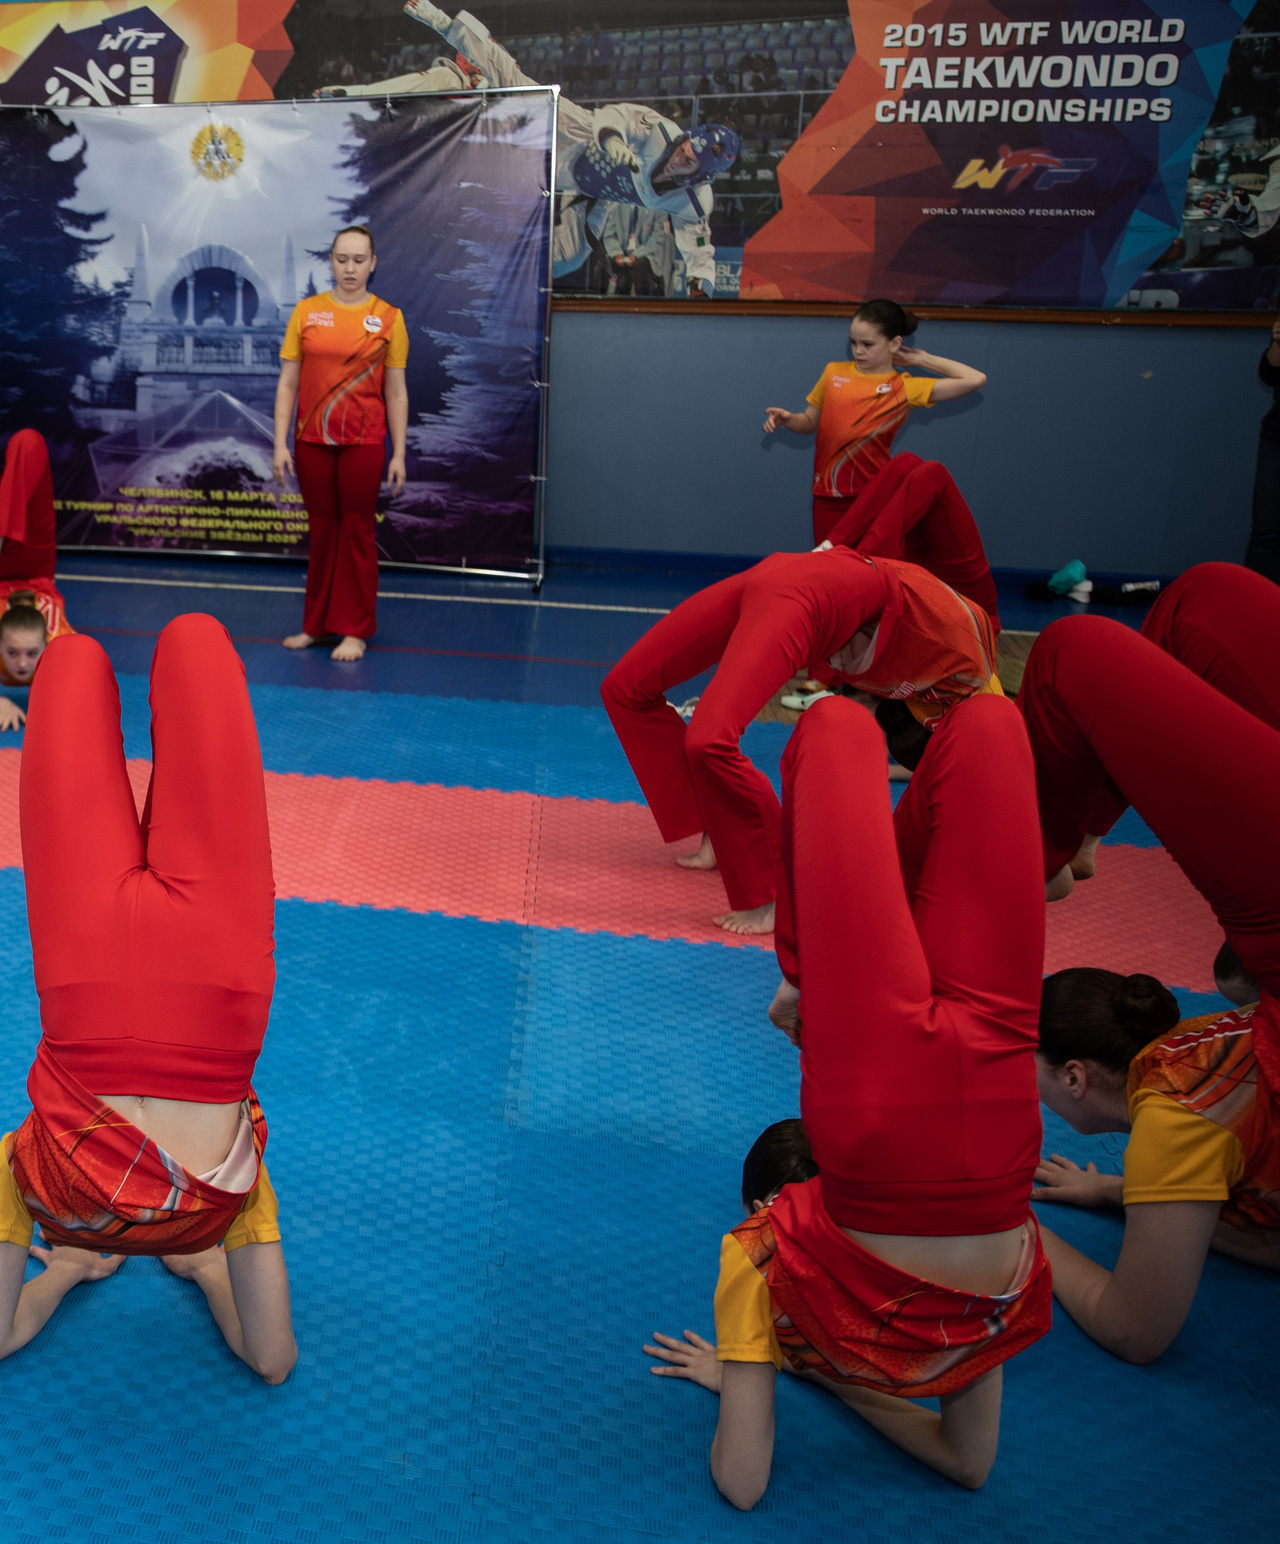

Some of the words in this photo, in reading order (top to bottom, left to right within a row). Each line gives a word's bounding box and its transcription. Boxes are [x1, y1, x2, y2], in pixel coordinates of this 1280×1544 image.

[883, 23, 968, 47] 2015
[979, 21, 1051, 46] WTF
[1060, 18, 1186, 45] WORLD
[879, 53, 1180, 90] TAEKWONDO
[874, 98, 1173, 123] CHAMPIONSHIPS
[952, 145, 1098, 194] WTF
[922, 207, 958, 216] WORLD
[961, 207, 1026, 216] TAEKWONDO
[1029, 208, 1096, 217] FEDERATION
[119, 487, 207, 501] ЧЕЛЯБИНСК,
[209, 489, 224, 501] 16
[226, 490, 276, 503] МАРТА
[280, 493, 305, 504] 202
[116, 503, 134, 513] ПО
[94, 513, 178, 527] УРАЛЬСКОГО
[180, 517, 284, 532] ФЕДЕРАЛЬНОГО
